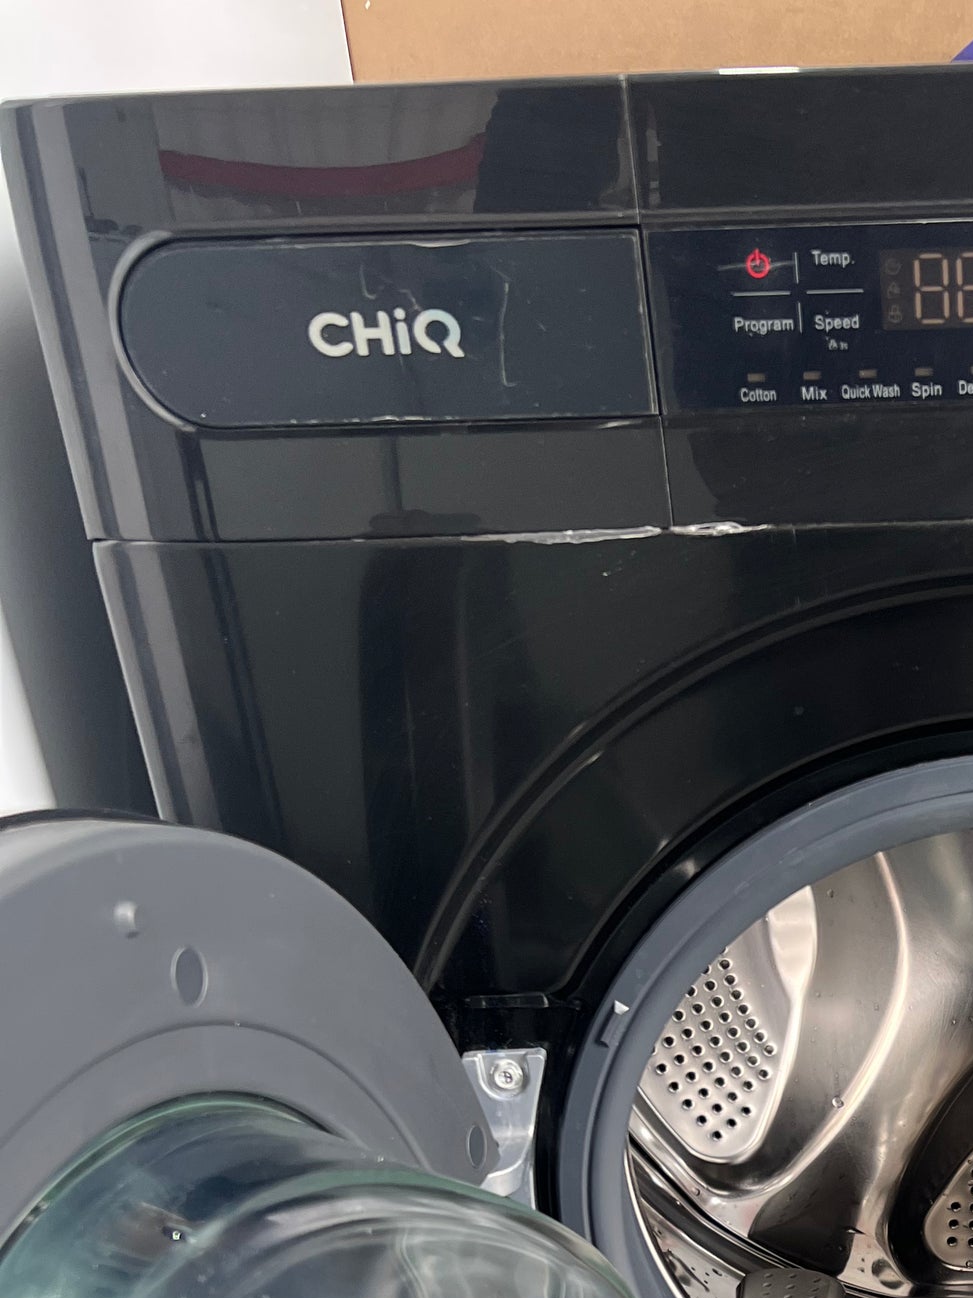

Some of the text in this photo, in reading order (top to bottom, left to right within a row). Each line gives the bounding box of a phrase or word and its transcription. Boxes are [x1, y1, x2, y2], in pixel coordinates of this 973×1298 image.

[811, 250, 855, 268] Temp.
[734, 317, 794, 334] Program
[814, 315, 860, 332] Speed
[308, 307, 465, 358] CHiQ
[740, 387, 777, 402] Cotton
[802, 386, 828, 401] Mix
[841, 384, 900, 400] Quick Wash
[911, 382, 943, 399] Spin
